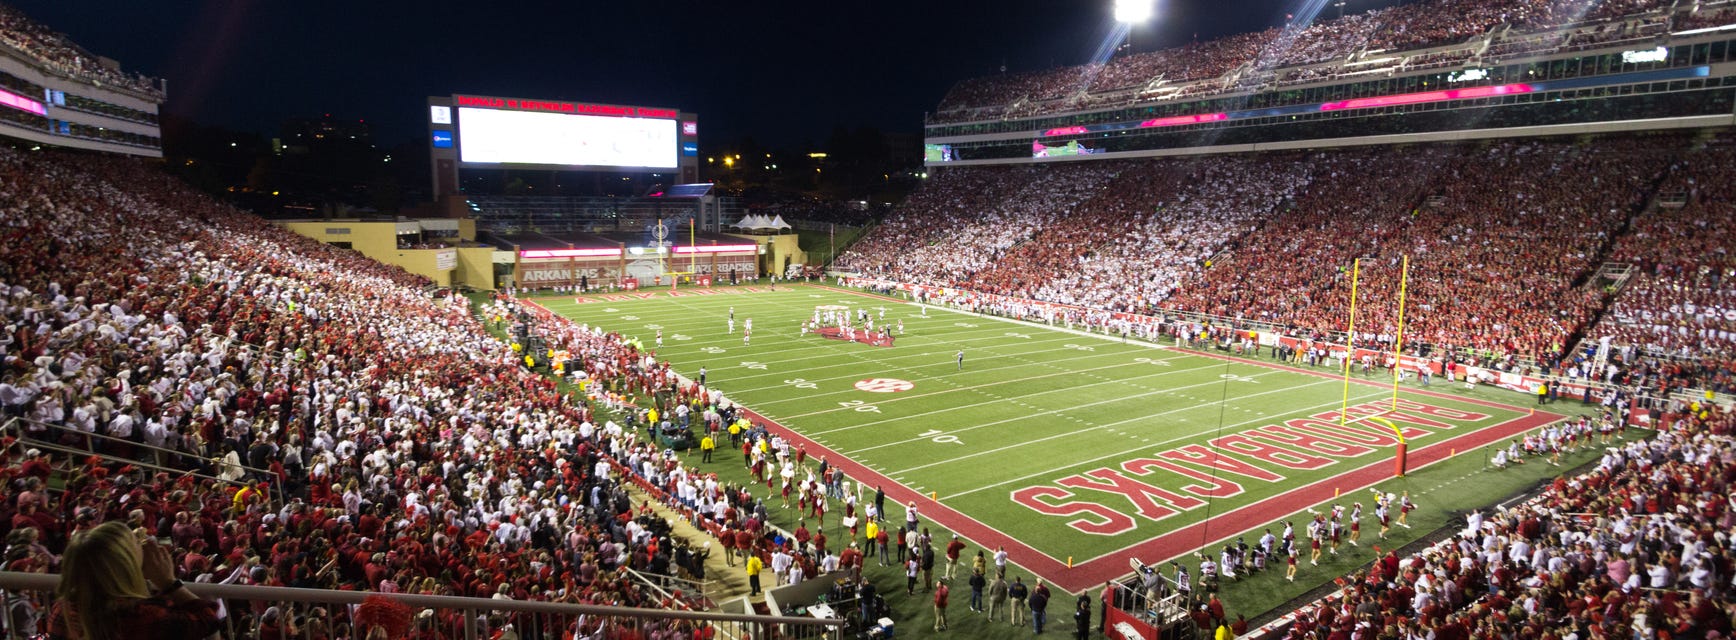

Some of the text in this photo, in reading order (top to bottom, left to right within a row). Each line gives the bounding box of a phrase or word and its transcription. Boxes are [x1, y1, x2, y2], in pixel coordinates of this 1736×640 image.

[458, 95, 504, 108] DONALD
[524, 268, 599, 282] ARKANSAS
[838, 400, 877, 415] 20
[918, 429, 957, 442] 10
[1010, 397, 1492, 535] RAZORBACKS
